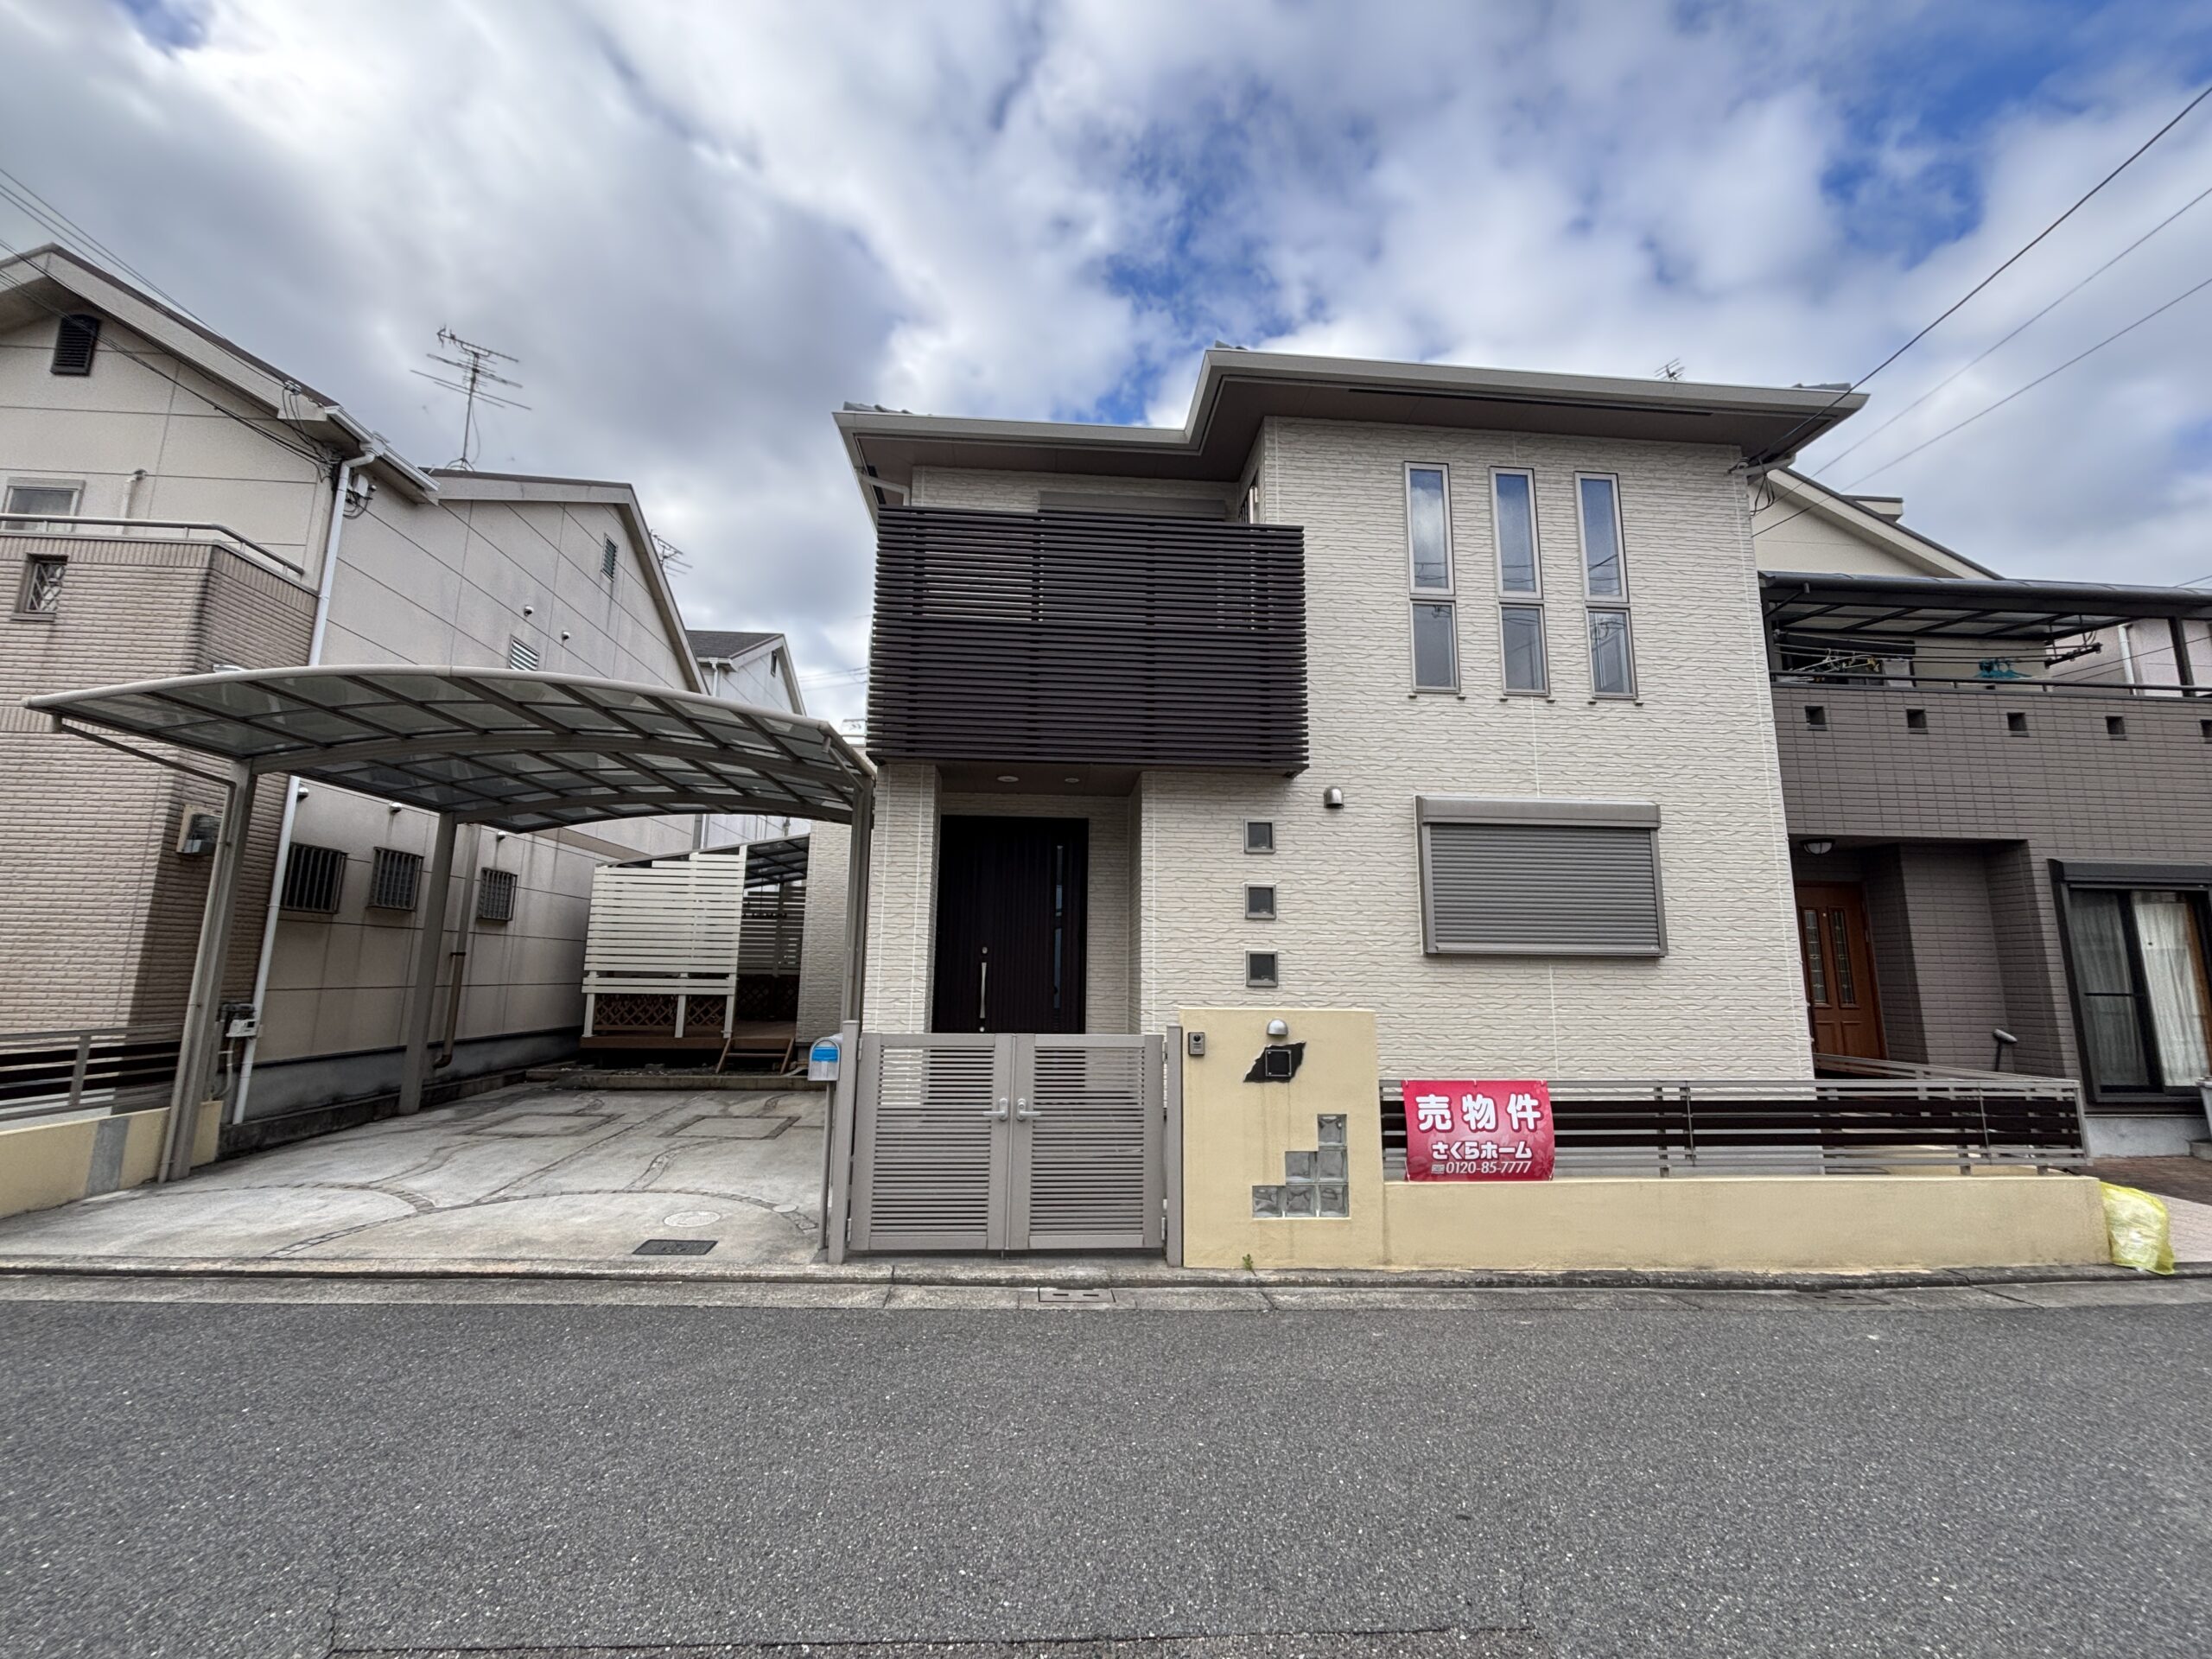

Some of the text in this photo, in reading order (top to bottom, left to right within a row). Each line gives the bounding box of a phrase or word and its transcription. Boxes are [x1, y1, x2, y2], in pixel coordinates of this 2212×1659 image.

[1415, 1093, 1541, 1130] 売物件
[1432, 1141, 1533, 1160] さくらホーム
[1446, 1160, 1532, 1174] 0120-85-7777
